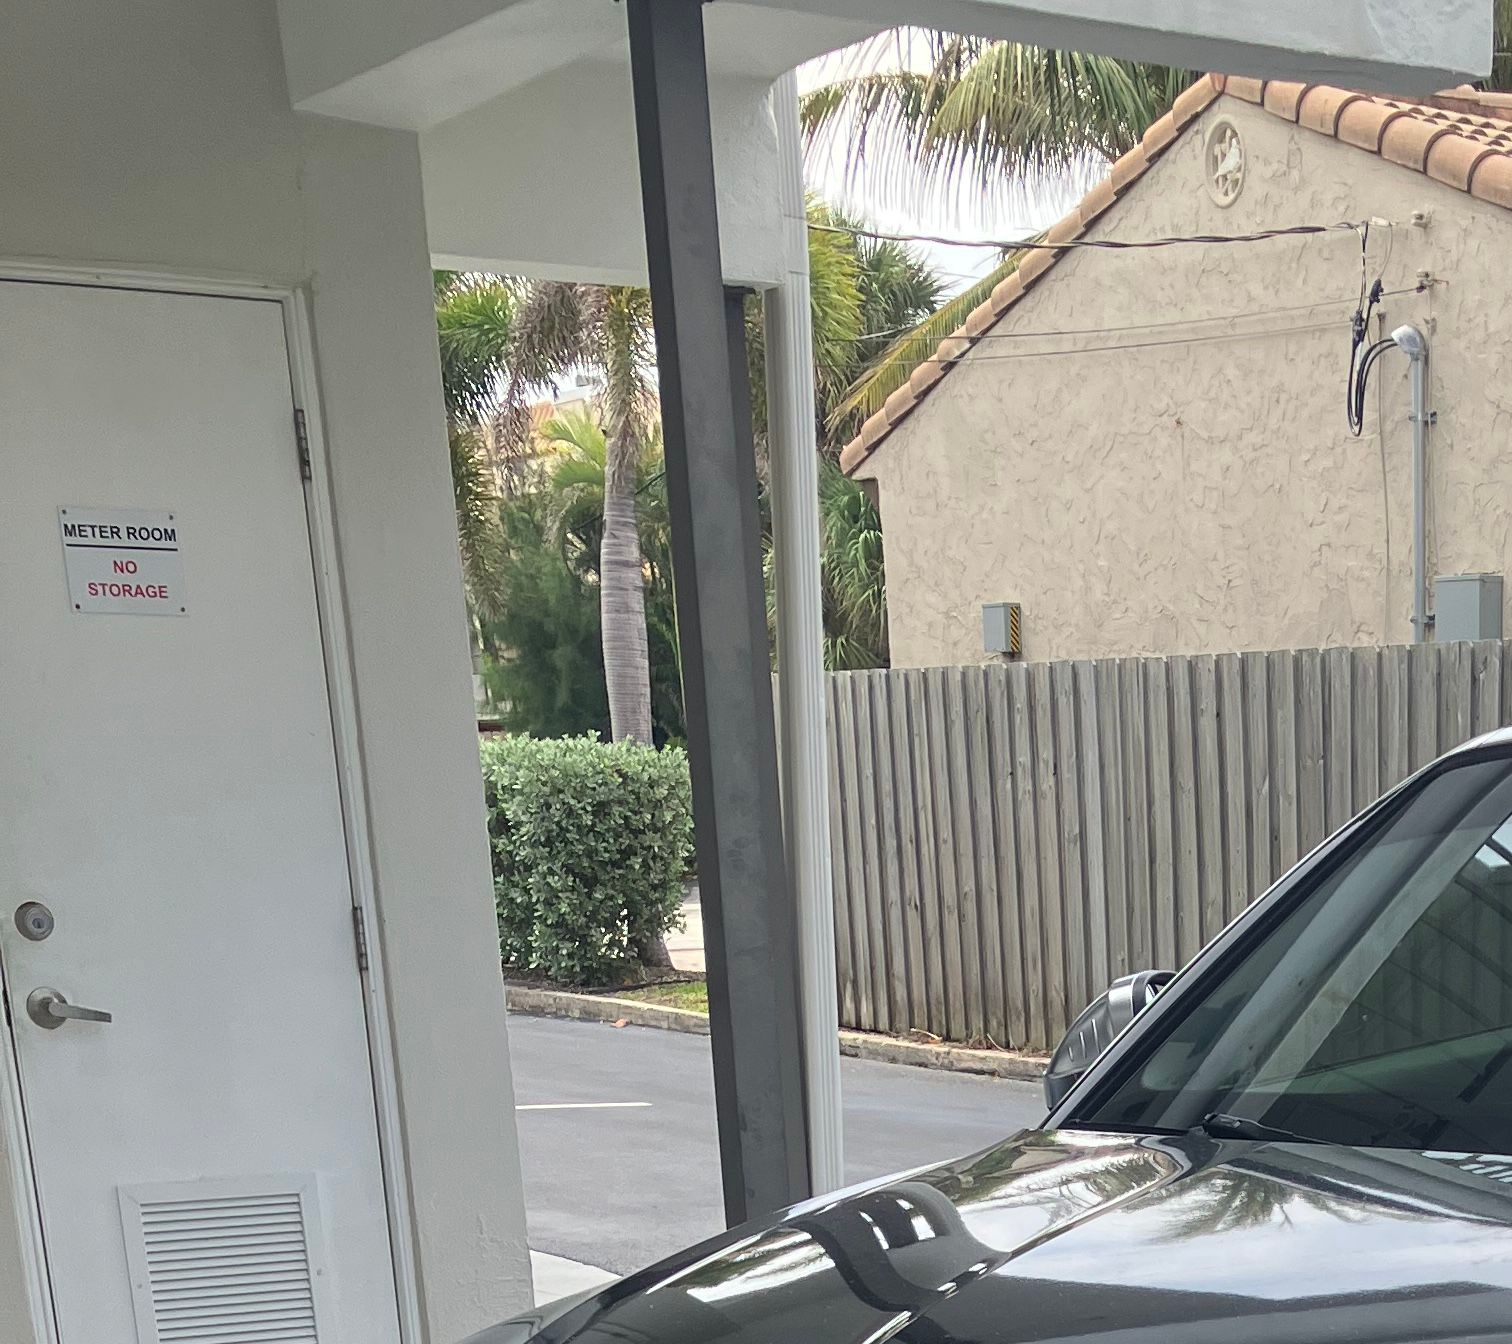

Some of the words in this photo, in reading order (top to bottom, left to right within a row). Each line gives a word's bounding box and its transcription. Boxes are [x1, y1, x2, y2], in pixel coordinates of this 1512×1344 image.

[63, 523, 122, 540] METER
[126, 525, 177, 542] ROOM
[113, 560, 138, 574] NO
[88, 582, 169, 599] STORAGE
